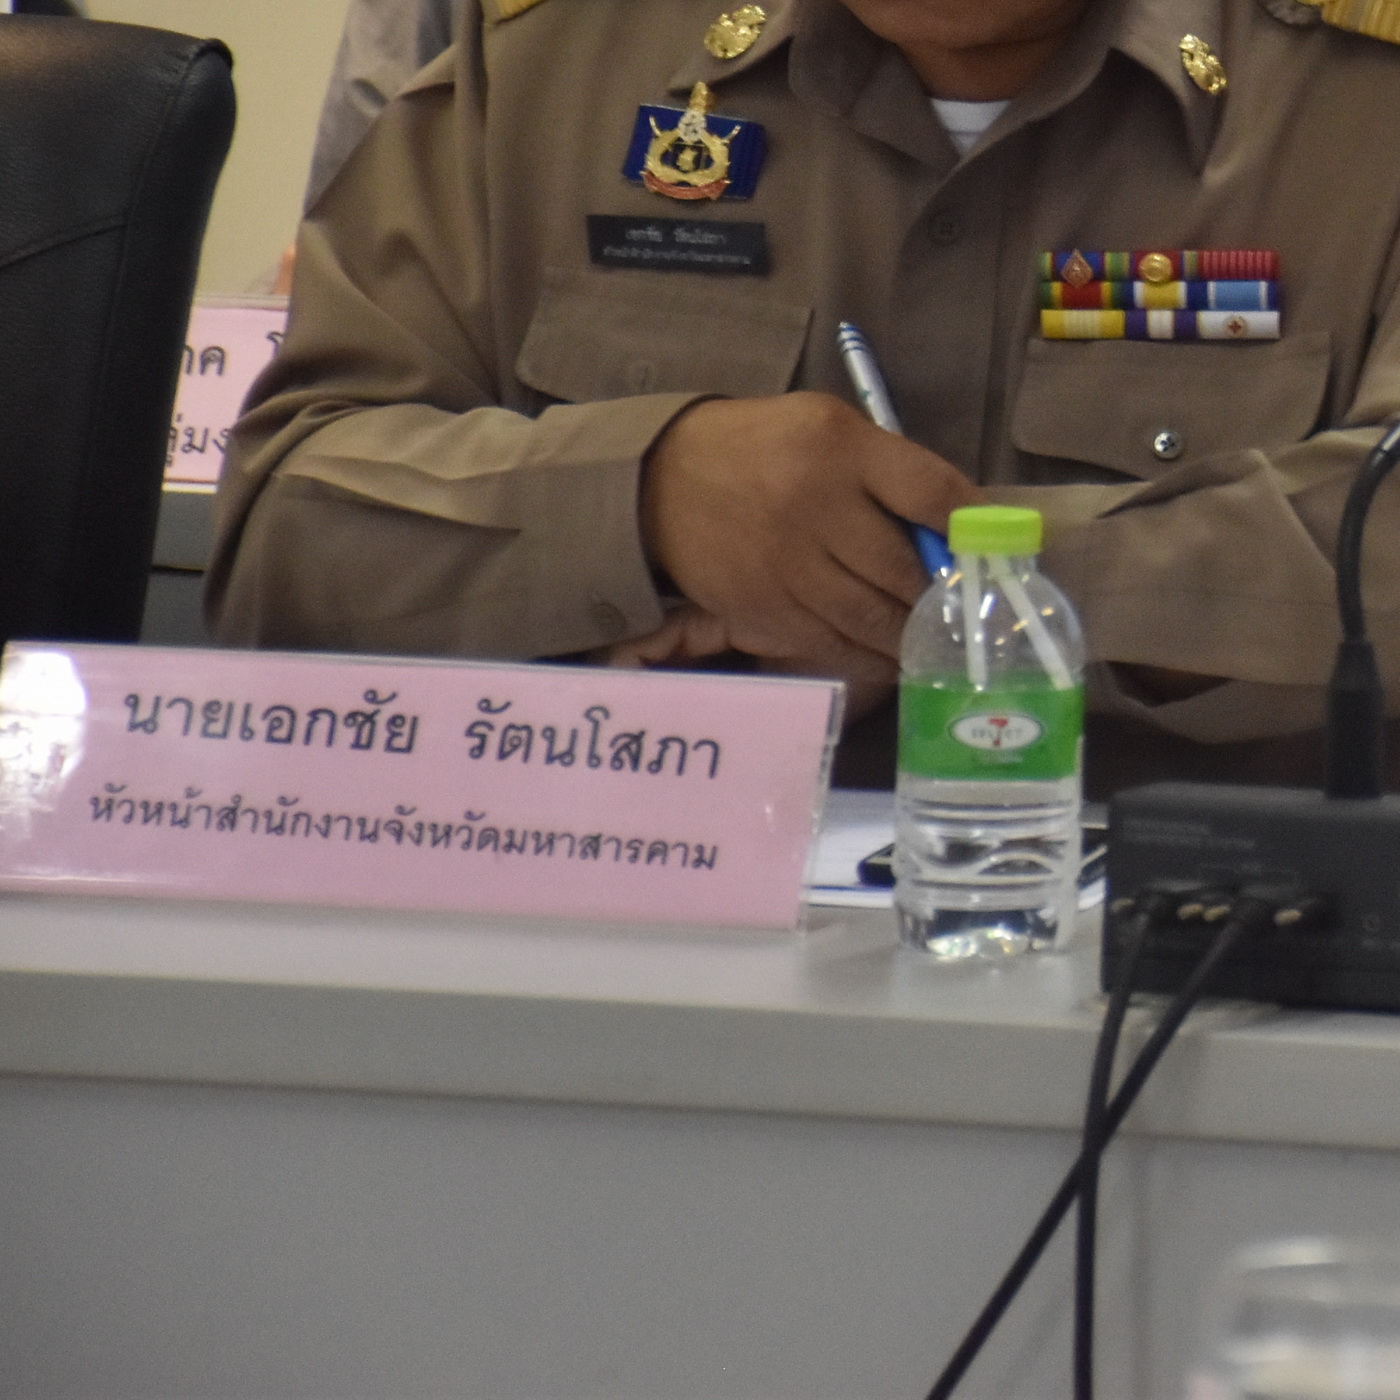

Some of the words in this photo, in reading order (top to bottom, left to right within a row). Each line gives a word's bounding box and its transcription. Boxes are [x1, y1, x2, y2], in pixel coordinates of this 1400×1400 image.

[123, 687, 420, 755] นายเอกชัย
[463, 696, 722, 780] รัตนโสภา
[90, 782, 719, 871] หัวหน้าสำนักงานจังหวัดมหาสารคาม
